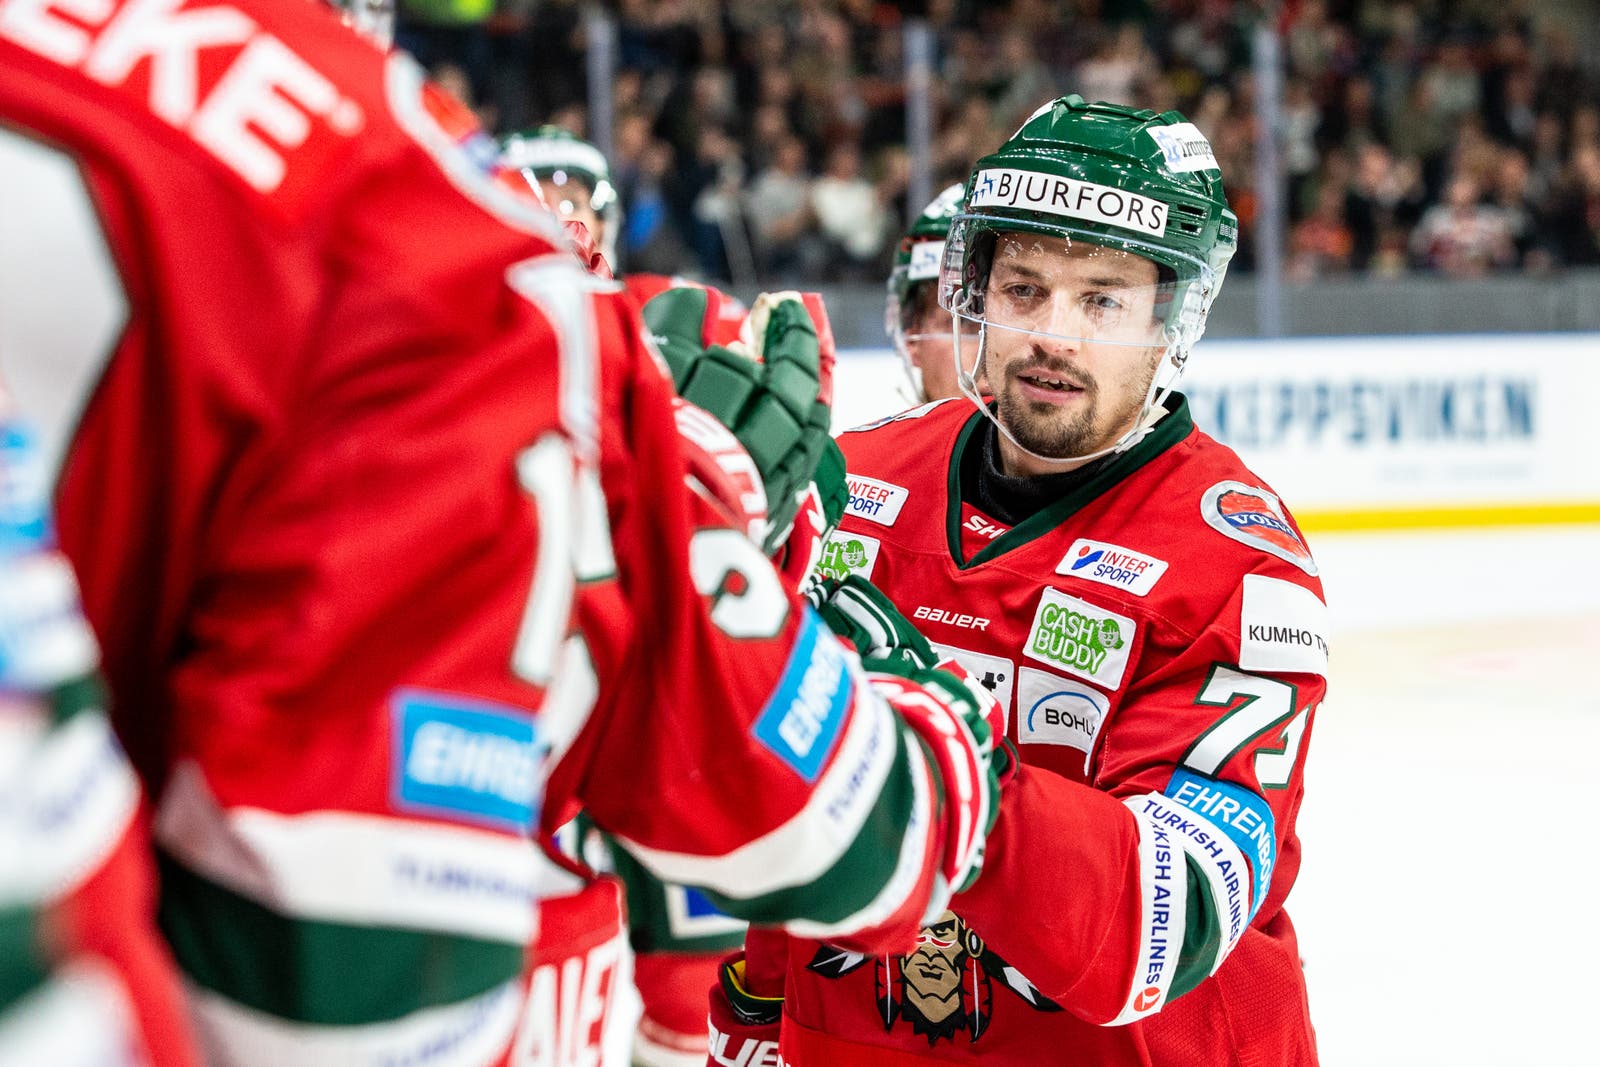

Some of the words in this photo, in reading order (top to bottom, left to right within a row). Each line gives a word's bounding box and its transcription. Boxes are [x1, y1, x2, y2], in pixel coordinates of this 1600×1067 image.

[997, 173, 1166, 231] BJURFORS
[847, 495, 884, 516] PORT
[962, 515, 1008, 539] SH
[1228, 512, 1296, 538] VOLV
[1093, 563, 1140, 586] SPORT
[1102, 550, 1148, 574] INTER
[1041, 606, 1095, 646] CASH
[1249, 624, 1313, 646] KUMHO
[1036, 630, 1105, 674] BUDDY
[1148, 820, 1171, 881] KISH
[1143, 799, 1223, 859] TURKISH
[1216, 859, 1242, 943] AIRLINES
[1146, 884, 1171, 985] AIRLINES
